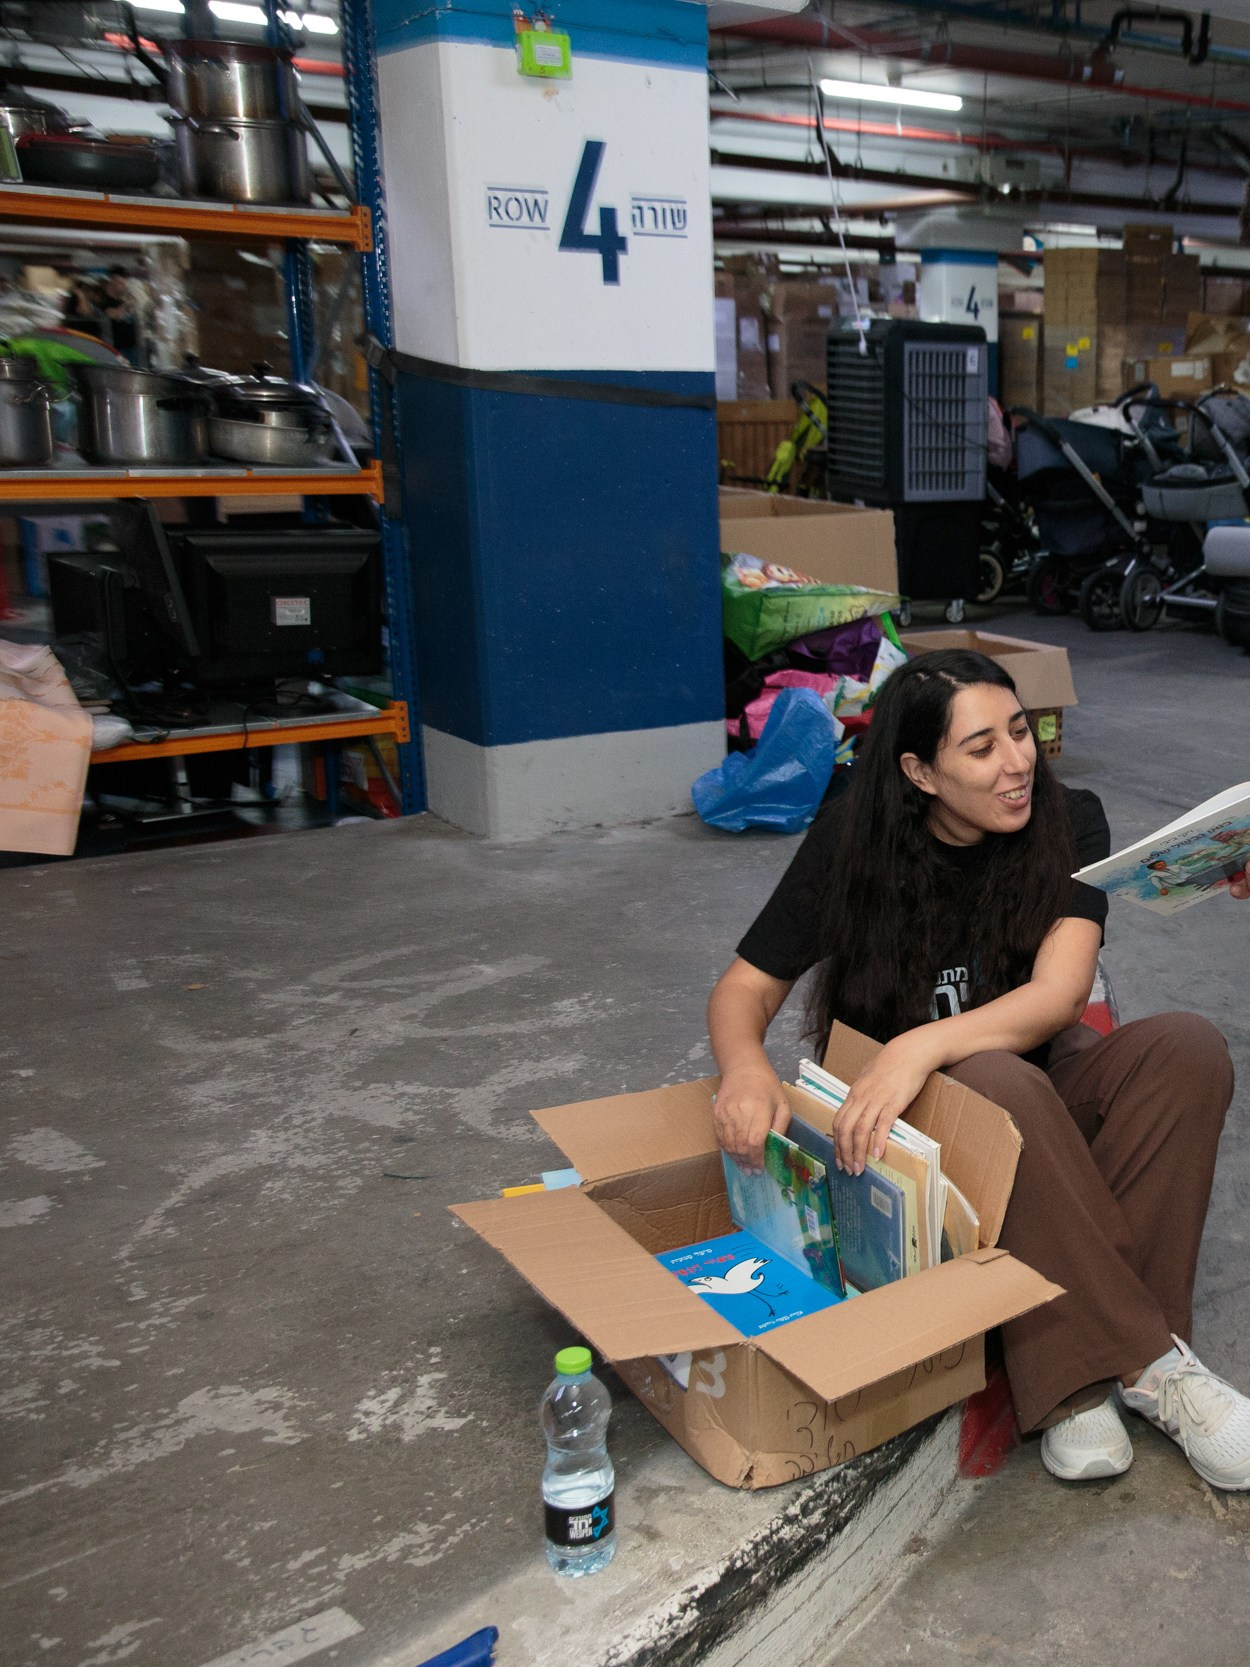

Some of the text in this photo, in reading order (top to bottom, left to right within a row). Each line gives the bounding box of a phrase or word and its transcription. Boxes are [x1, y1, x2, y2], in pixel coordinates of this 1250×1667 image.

[487, 139, 629, 287] ROW 4
[631, 204, 688, 231] שורה
[965, 285, 980, 321] 4
